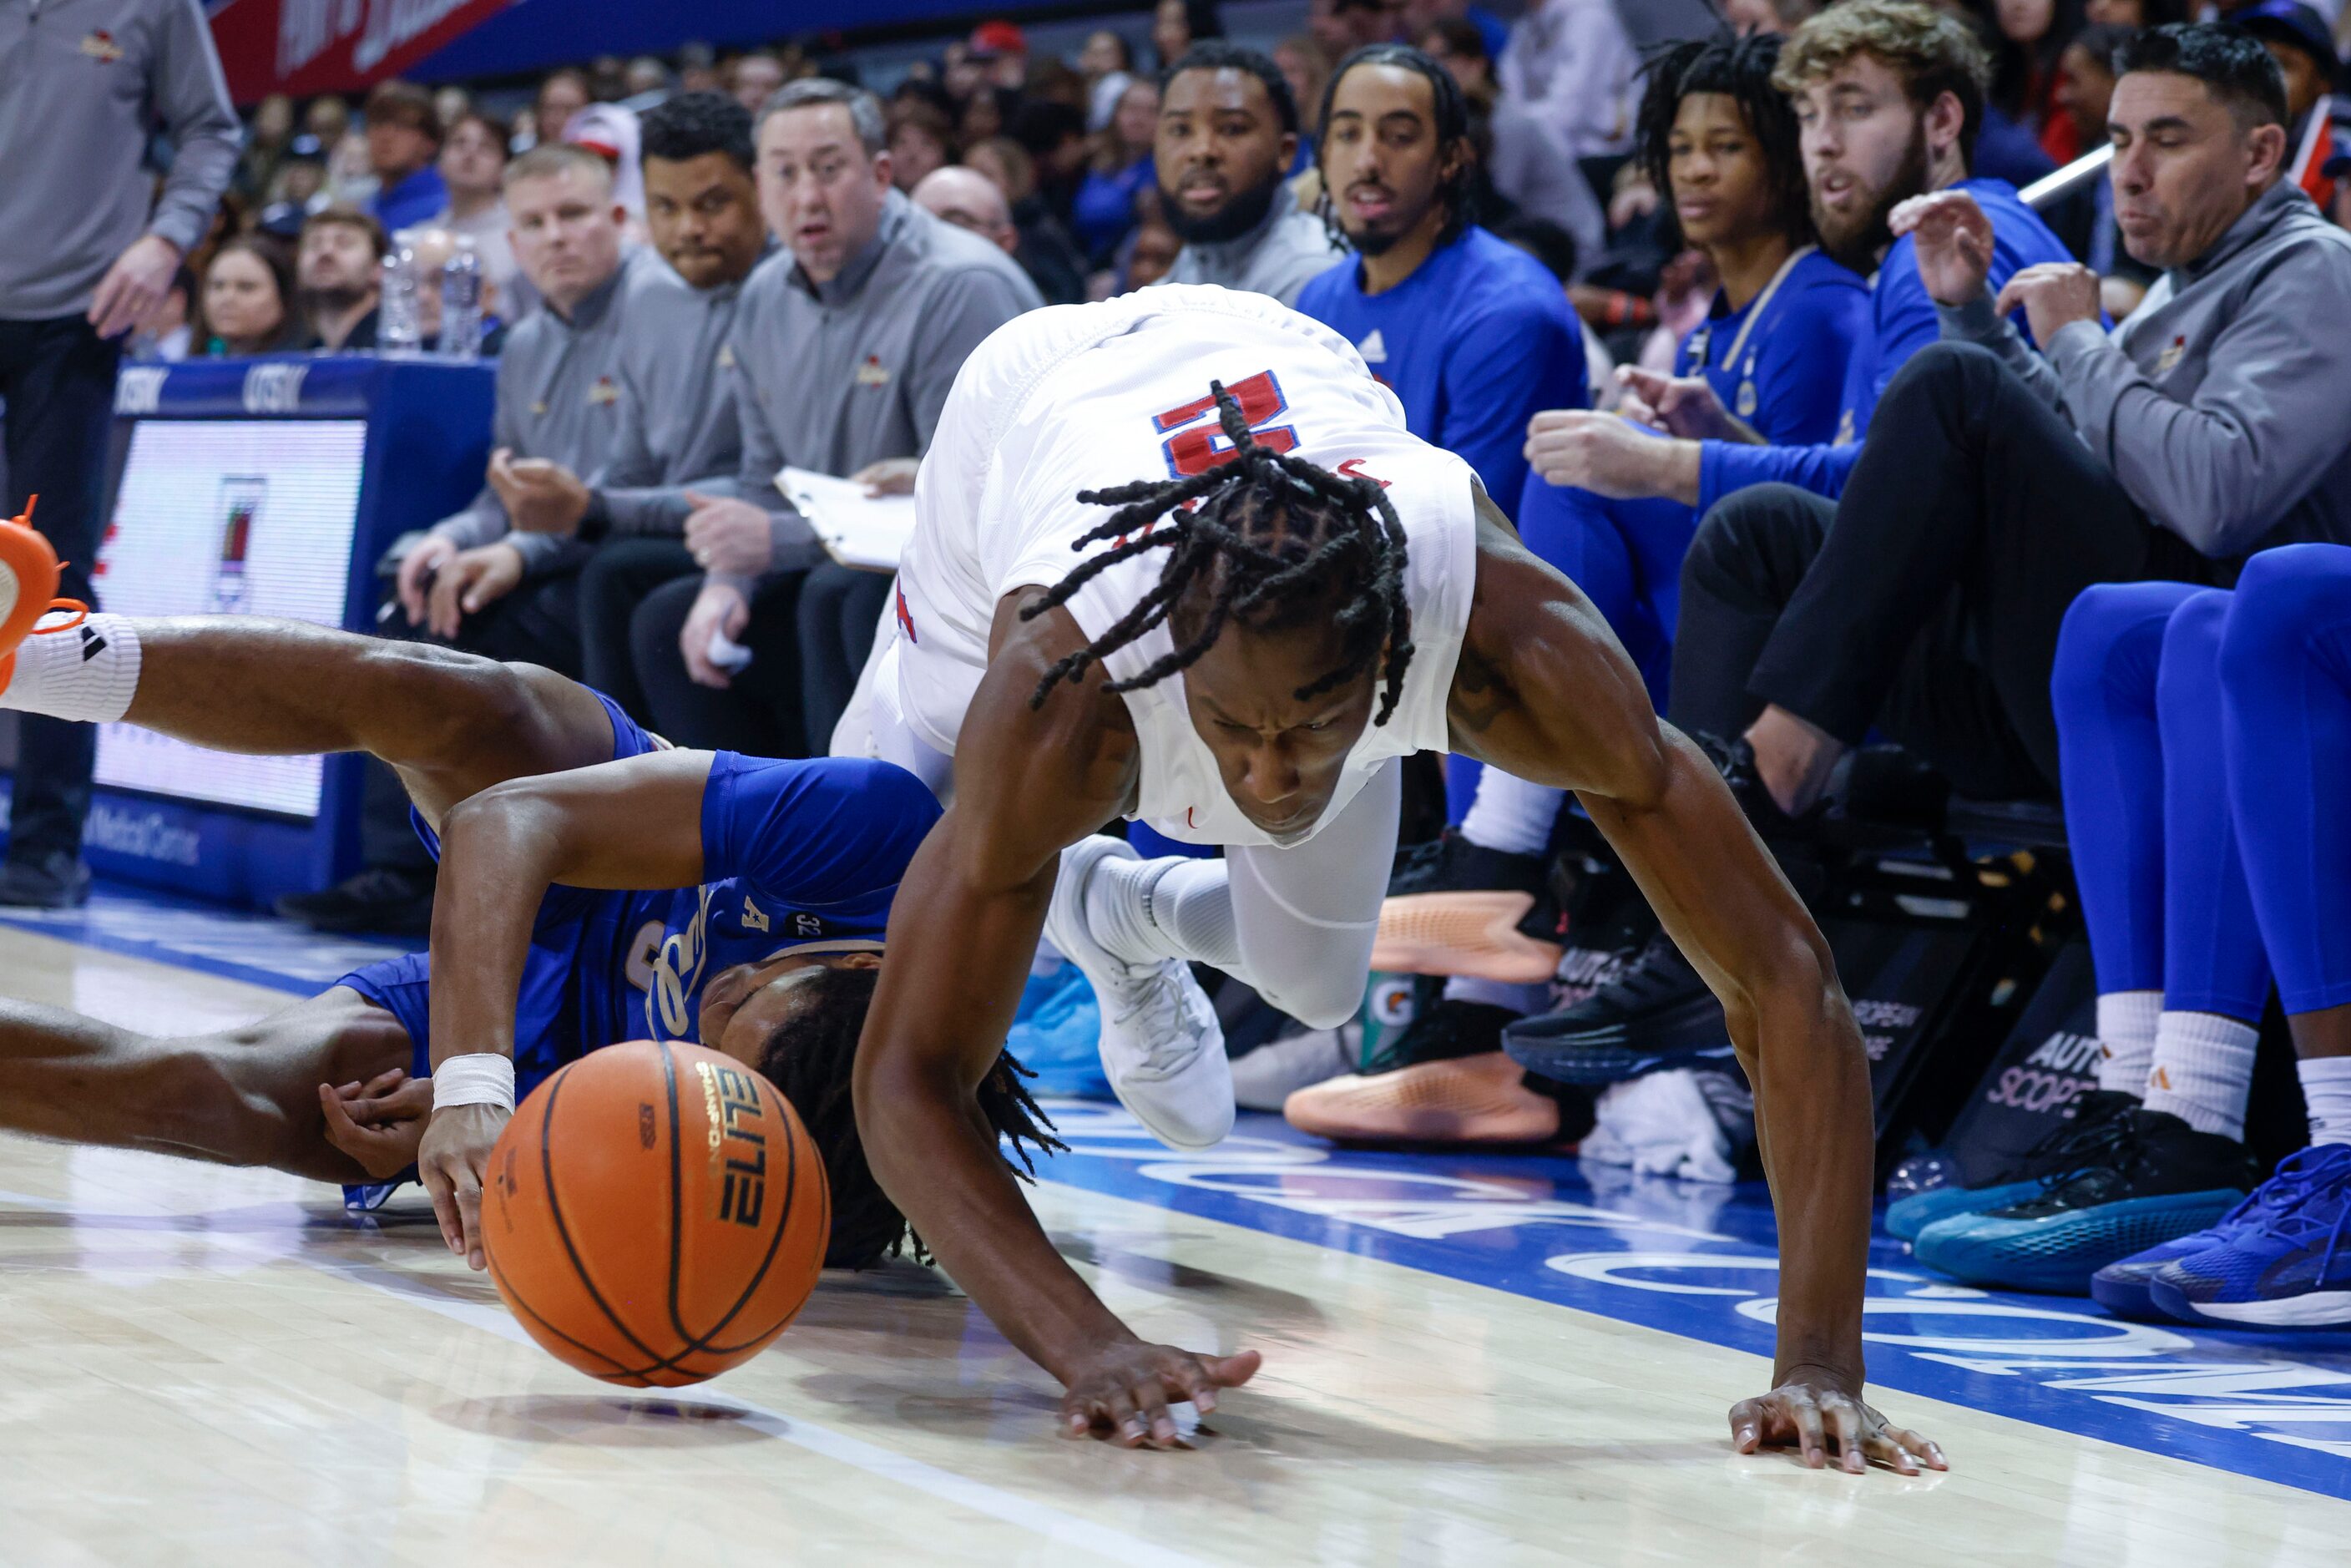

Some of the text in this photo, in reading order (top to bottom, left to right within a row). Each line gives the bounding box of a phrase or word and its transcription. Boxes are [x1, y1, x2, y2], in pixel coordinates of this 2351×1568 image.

[741, 895, 769, 933] A
[796, 913, 822, 936] 32
[710, 1064, 765, 1228] ELITE
